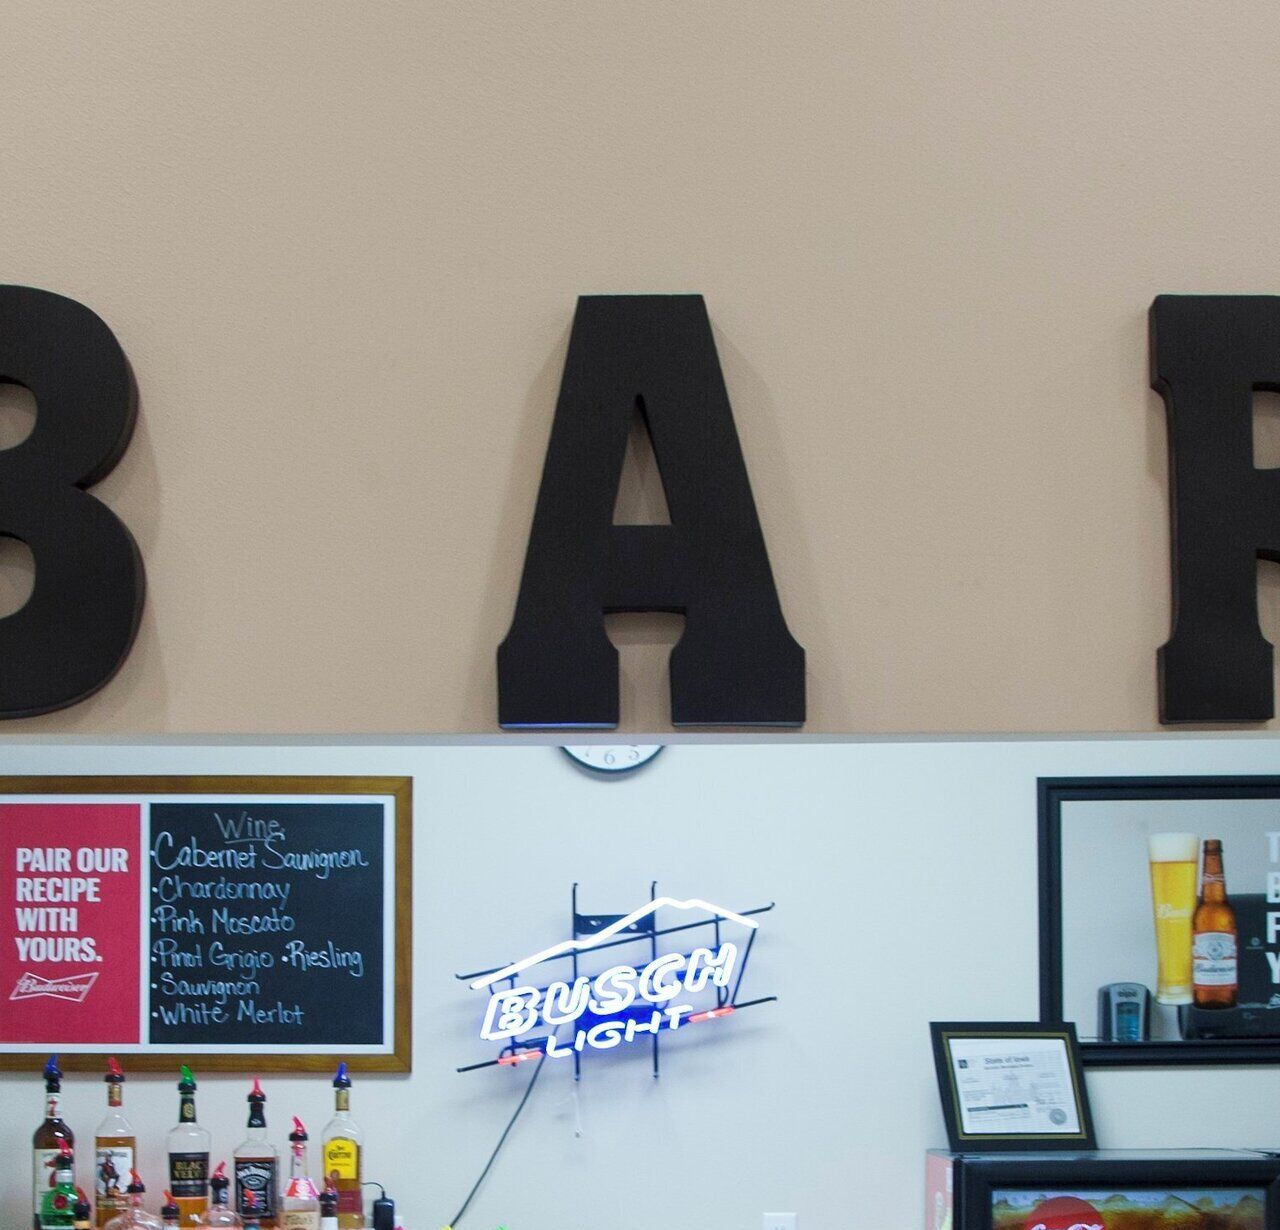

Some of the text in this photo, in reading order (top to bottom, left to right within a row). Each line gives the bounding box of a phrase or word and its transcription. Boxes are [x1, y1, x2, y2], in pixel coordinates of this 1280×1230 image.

[17, 847, 129, 873] PAIR OUR
[154, 831, 255, 871] Cabernet
[17, 878, 100, 903] RECIPE
[158, 877, 291, 911] Chardonnay
[16, 908, 78, 932] WITH
[158, 907, 296, 935] Pink Moscato
[16, 937, 104, 963] YOURS.
[209, 940, 274, 978] Grigio
[287, 940, 364, 977] Riesling
[160, 971, 261, 1004] Sauvignon
[480, 943, 738, 1041] BUSCH
[158, 1001, 306, 1026] White Merlot
[546, 1005, 694, 1058] LIGHT
